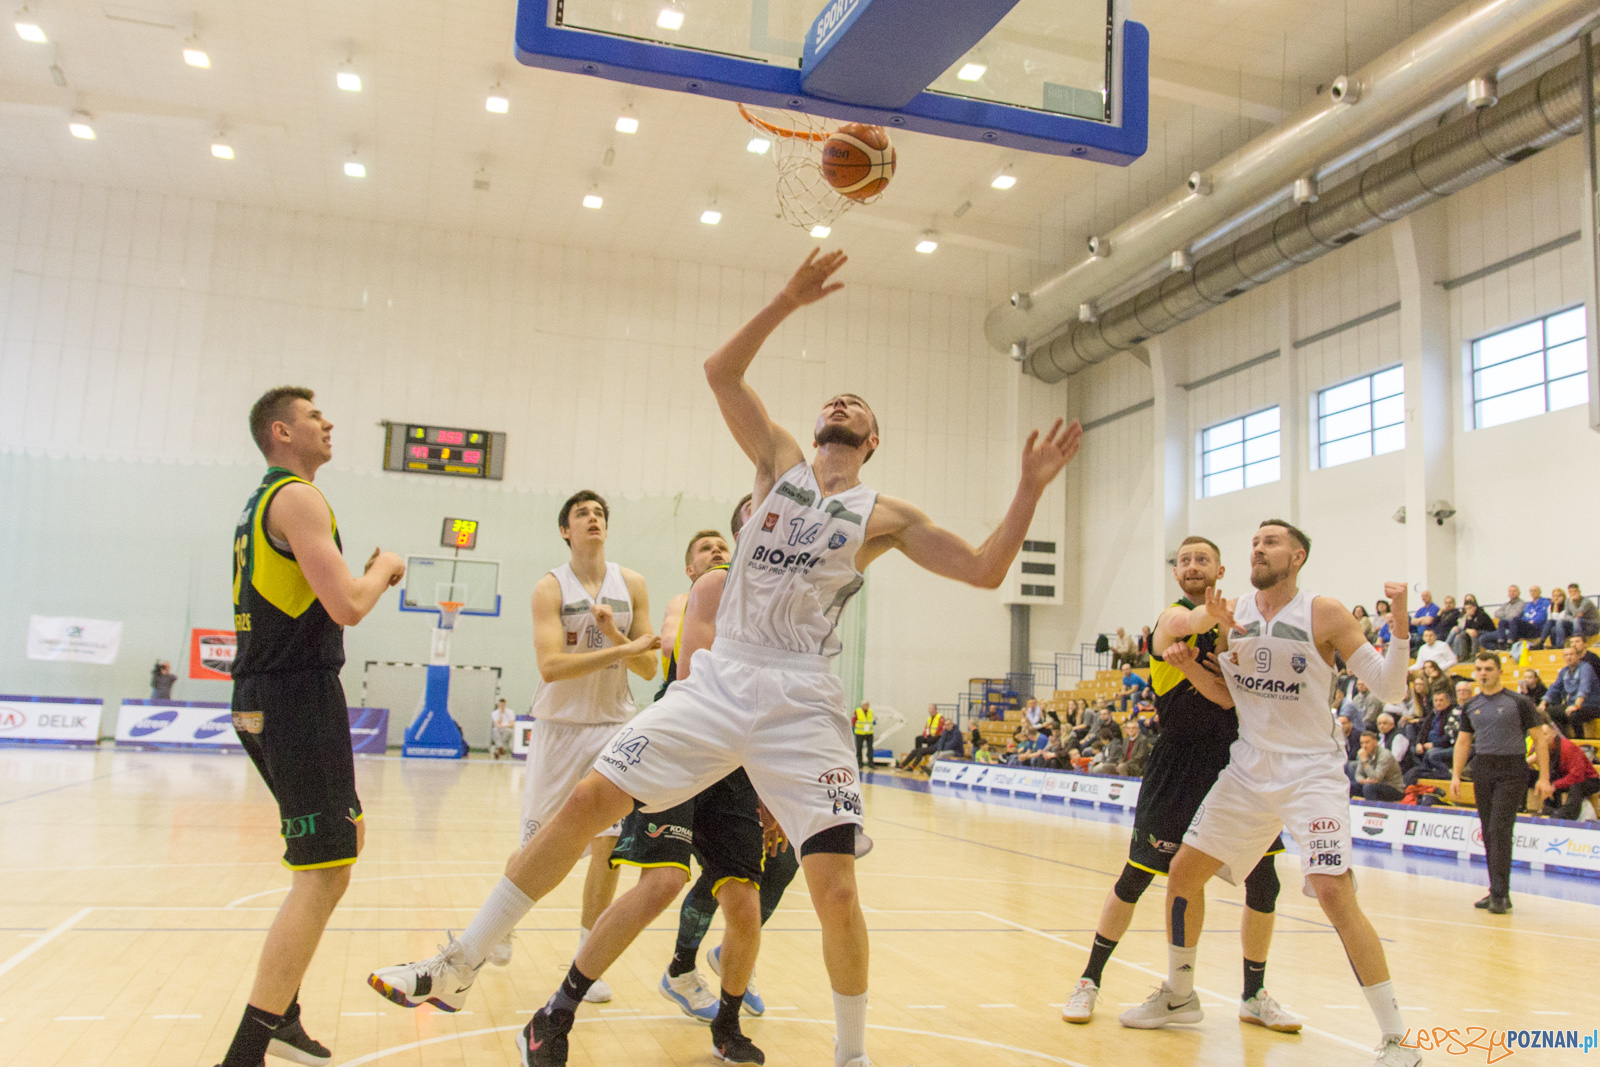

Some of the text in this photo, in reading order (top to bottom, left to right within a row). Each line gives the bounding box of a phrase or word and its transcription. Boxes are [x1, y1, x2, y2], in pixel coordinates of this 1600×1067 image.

[788, 518, 823, 547] 14
[1255, 647, 1272, 674] 9
[38, 713, 86, 728] DELIK
[612, 728, 649, 766] 14
[825, 772, 852, 785] KIA
[1312, 821, 1336, 831] KIA
[1420, 823, 1466, 841] NICKEL
[1310, 840, 1341, 849] DELIK
[1317, 853, 1342, 866] PBG
